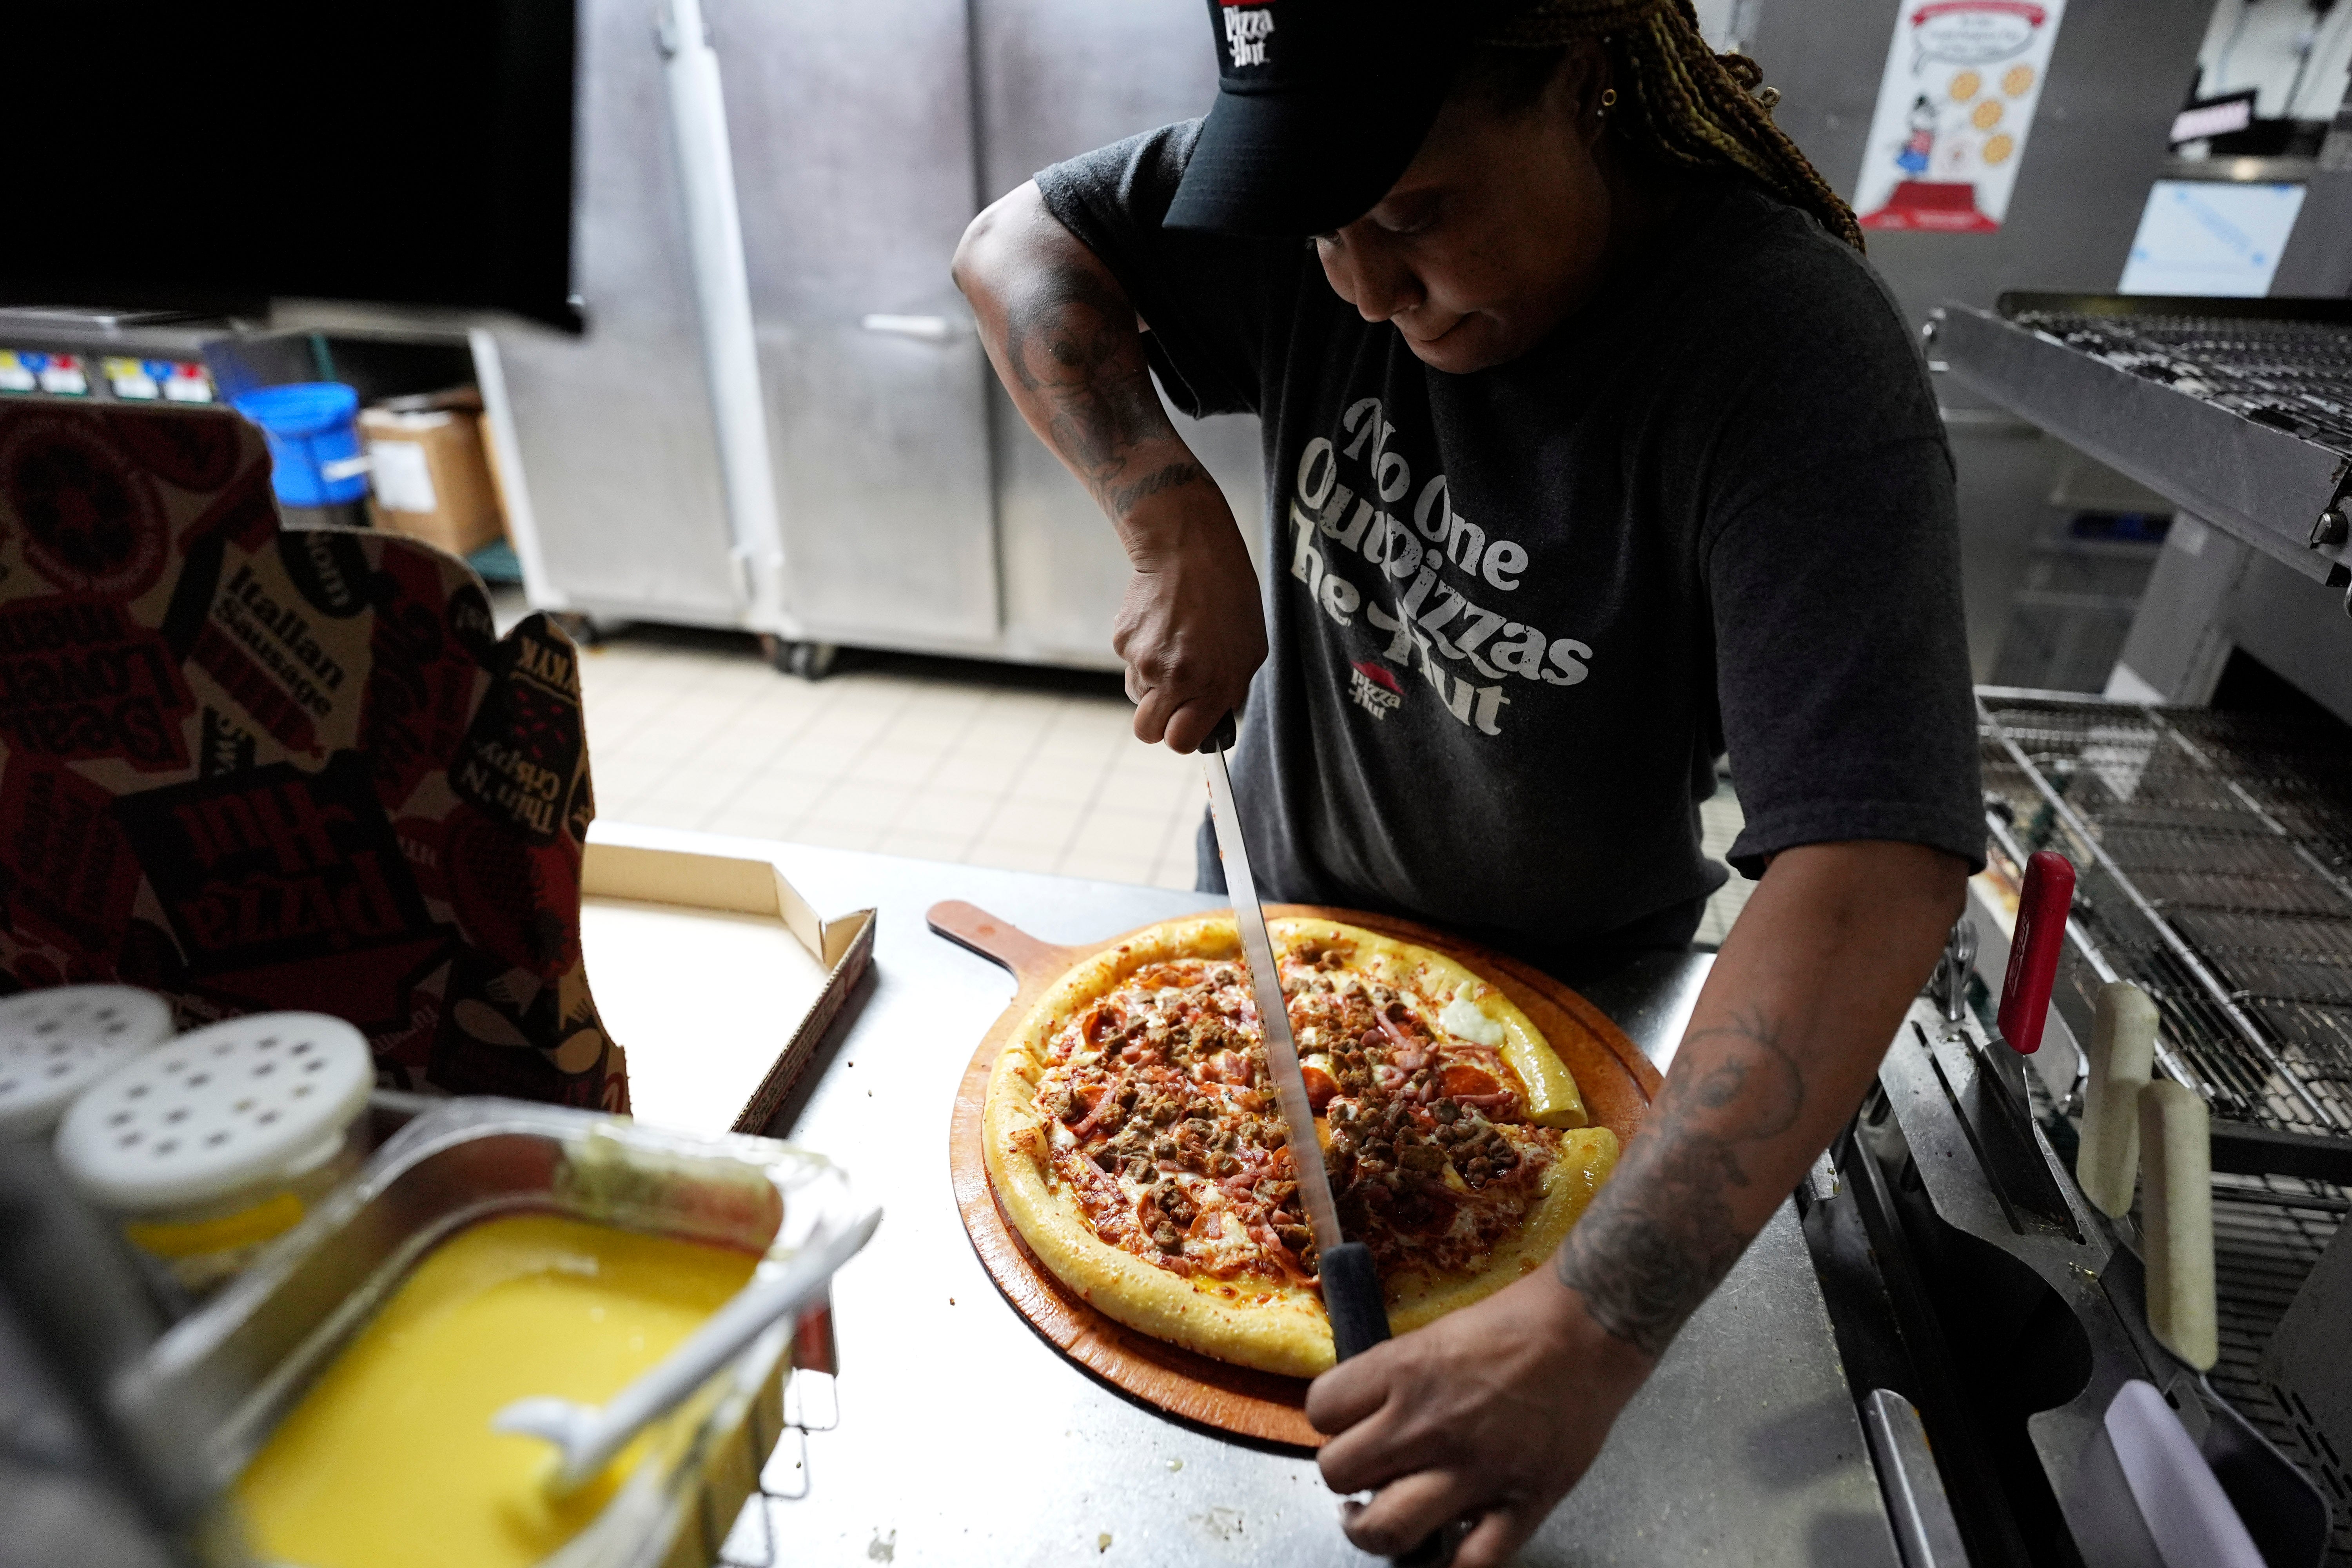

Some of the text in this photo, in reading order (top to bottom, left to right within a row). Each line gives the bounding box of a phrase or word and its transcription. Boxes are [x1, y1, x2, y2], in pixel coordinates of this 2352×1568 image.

[1223, 5, 1275, 42] Pizza
[1229, 34, 1266, 67] Hut
[1343, 397, 1529, 591] No One
[212, 594, 333, 720] Sausage
[226, 565, 345, 691] Italian
[1367, 597, 1511, 736] Hut
[1348, 686, 1387, 720] Hut
[1350, 667, 1401, 710] Pizza
[476, 739, 561, 802] Crispy
[495, 782, 555, 835] Thin
[172, 779, 358, 871] Hut
[176, 849, 407, 951] Pizza
